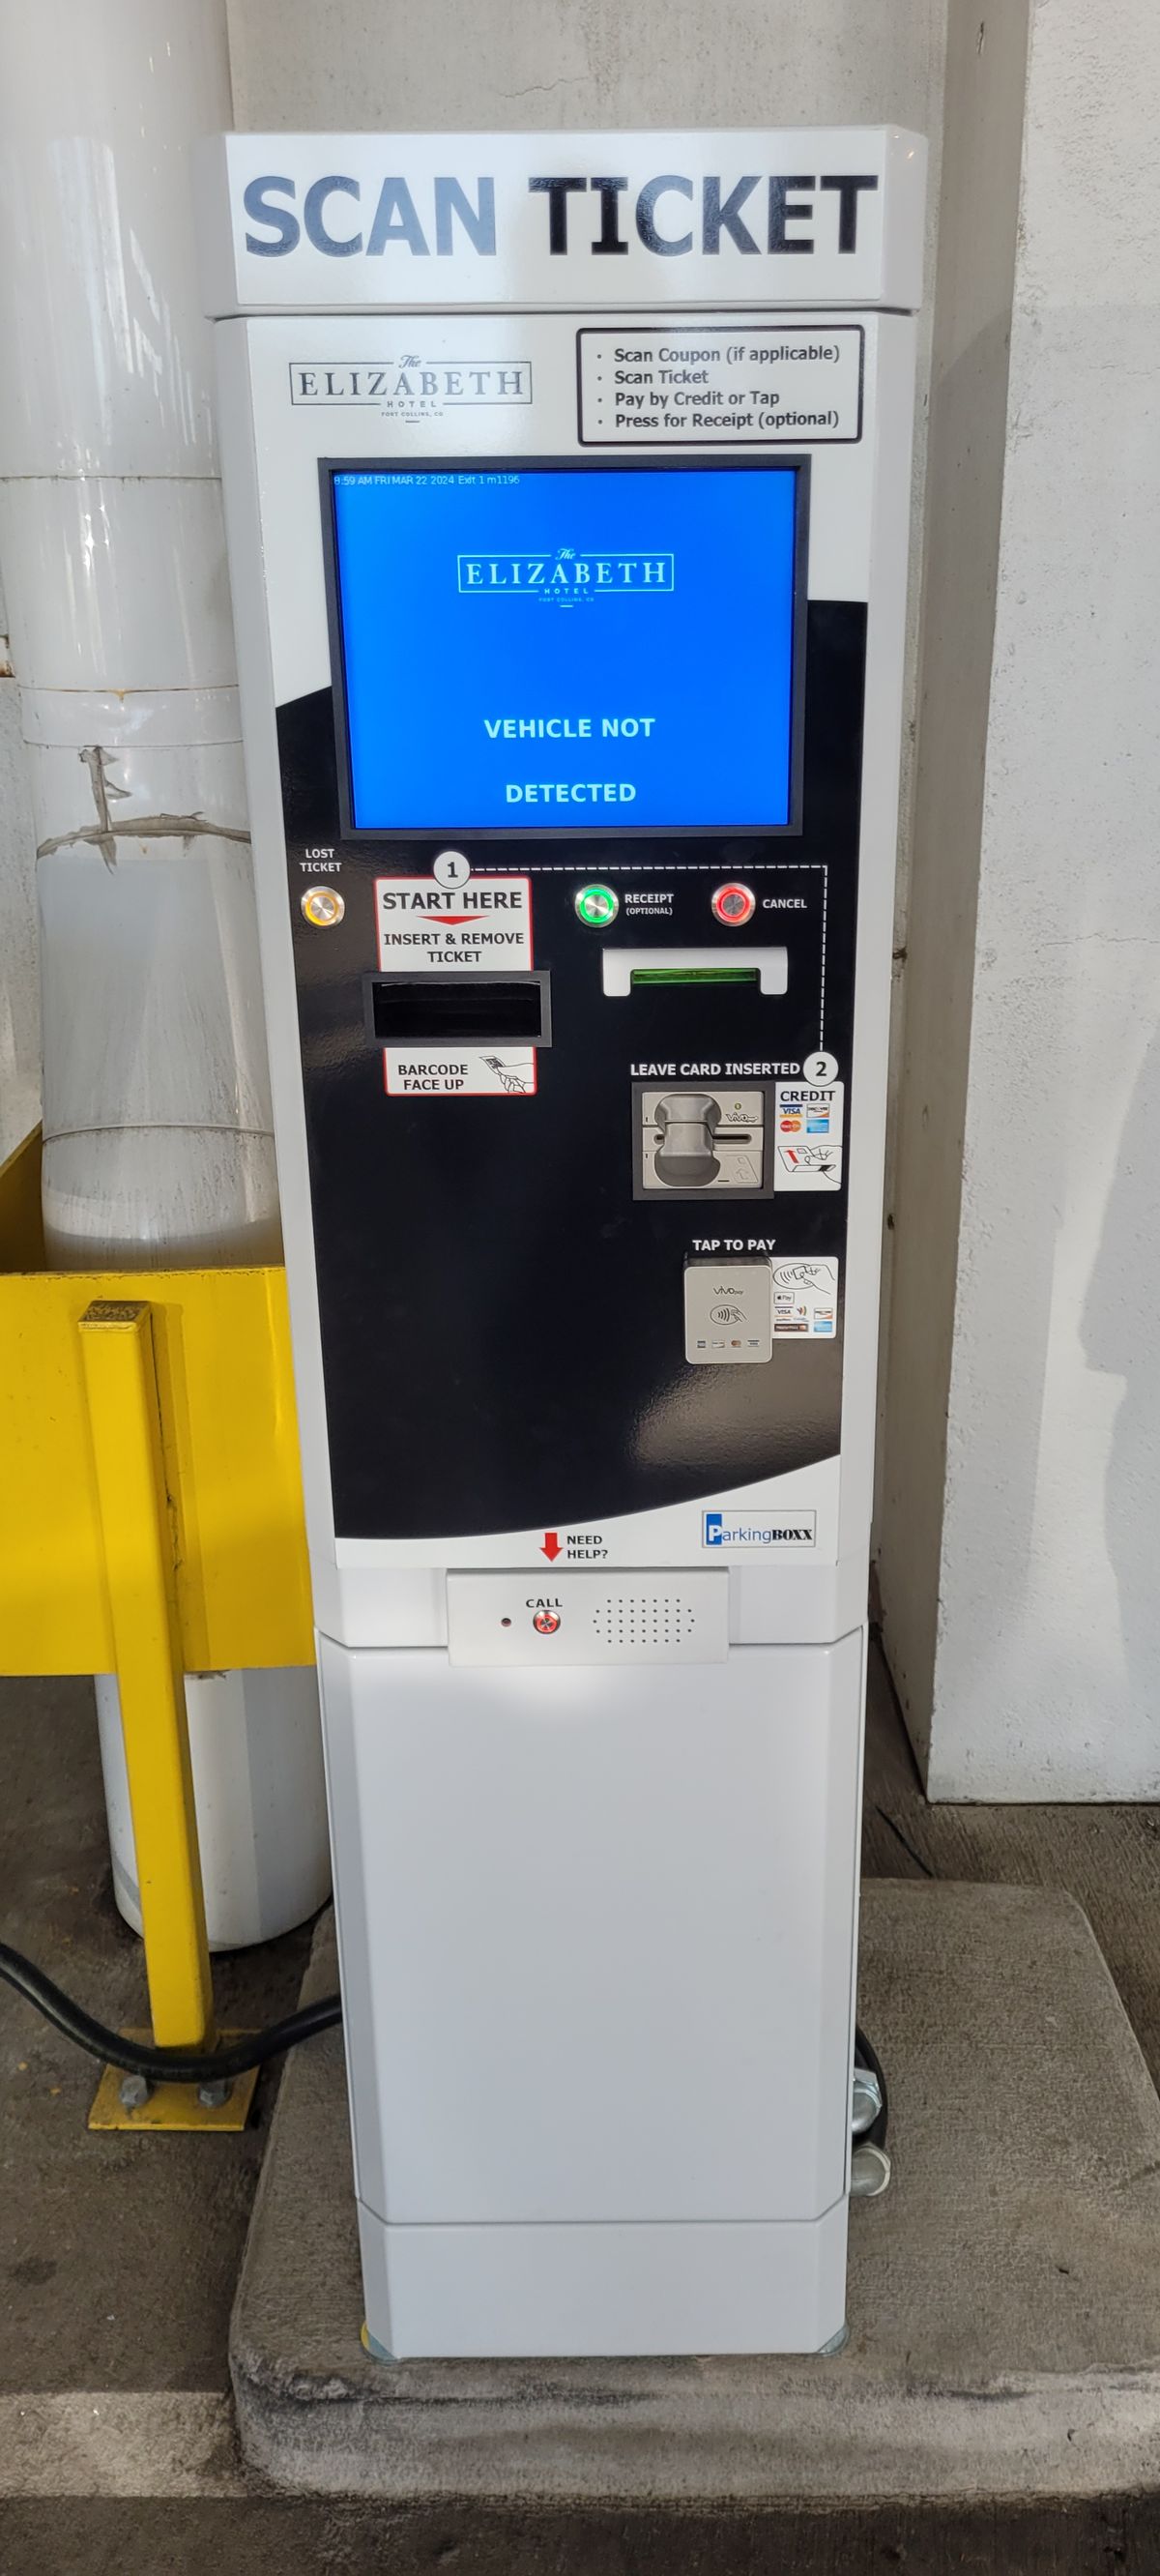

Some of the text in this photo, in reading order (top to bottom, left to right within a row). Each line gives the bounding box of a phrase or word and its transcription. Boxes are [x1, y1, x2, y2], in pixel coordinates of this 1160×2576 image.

[243, 175, 879, 257] SCAN TICKET
[398, 355, 421, 368] The
[614, 345, 840, 365] Scan Coupon (if applicable)
[298, 371, 523, 395] ELIZABETH
[614, 369, 709, 384] Scan Ticket
[615, 391, 779, 409] Pay by Credit or Tap
[615, 411, 839, 429] Press for Receipt (optional)
[358, 476, 373, 485] AM
[375, 476, 391, 485] FRI
[392, 476, 414, 485] MAR
[416, 475, 427, 485] 22
[431, 475, 454, 484] 2024
[458, 475, 476, 484] Exit
[479, 475, 484, 484] 1
[555, 548, 575, 561] The
[466, 562, 666, 585] ELIZABETH
[483, 717, 655, 739] VEHICLE NOT
[506, 783, 636, 803] DETECTED
[304, 848, 334, 859] LOST
[300, 862, 342, 872] TICKET
[448, 862, 458, 878] 1
[383, 892, 522, 910] START HERE
[624, 893, 674, 904] RECEIPT
[763, 898, 807, 909] CANCEL
[625, 907, 673, 916] (OPTIONAL)
[384, 932, 524, 946] INSERT & REMOVE
[427, 951, 481, 963] TICKET
[397, 1064, 469, 1076] BARCODE
[630, 1063, 800, 1076] LEAVE CARD INSERTED
[815, 1062, 827, 1076] 2
[403, 1079, 464, 1091] FACE UP
[780, 1090, 835, 1101] CREDIT
[692, 1239, 776, 1251] TAP TO PAY
[566, 1536, 602, 1545] NEED
[708, 1525, 812, 1544] ParkingBOXX
[566, 1549, 608, 1560] HELP?
[526, 1598, 563, 1608] CALL
